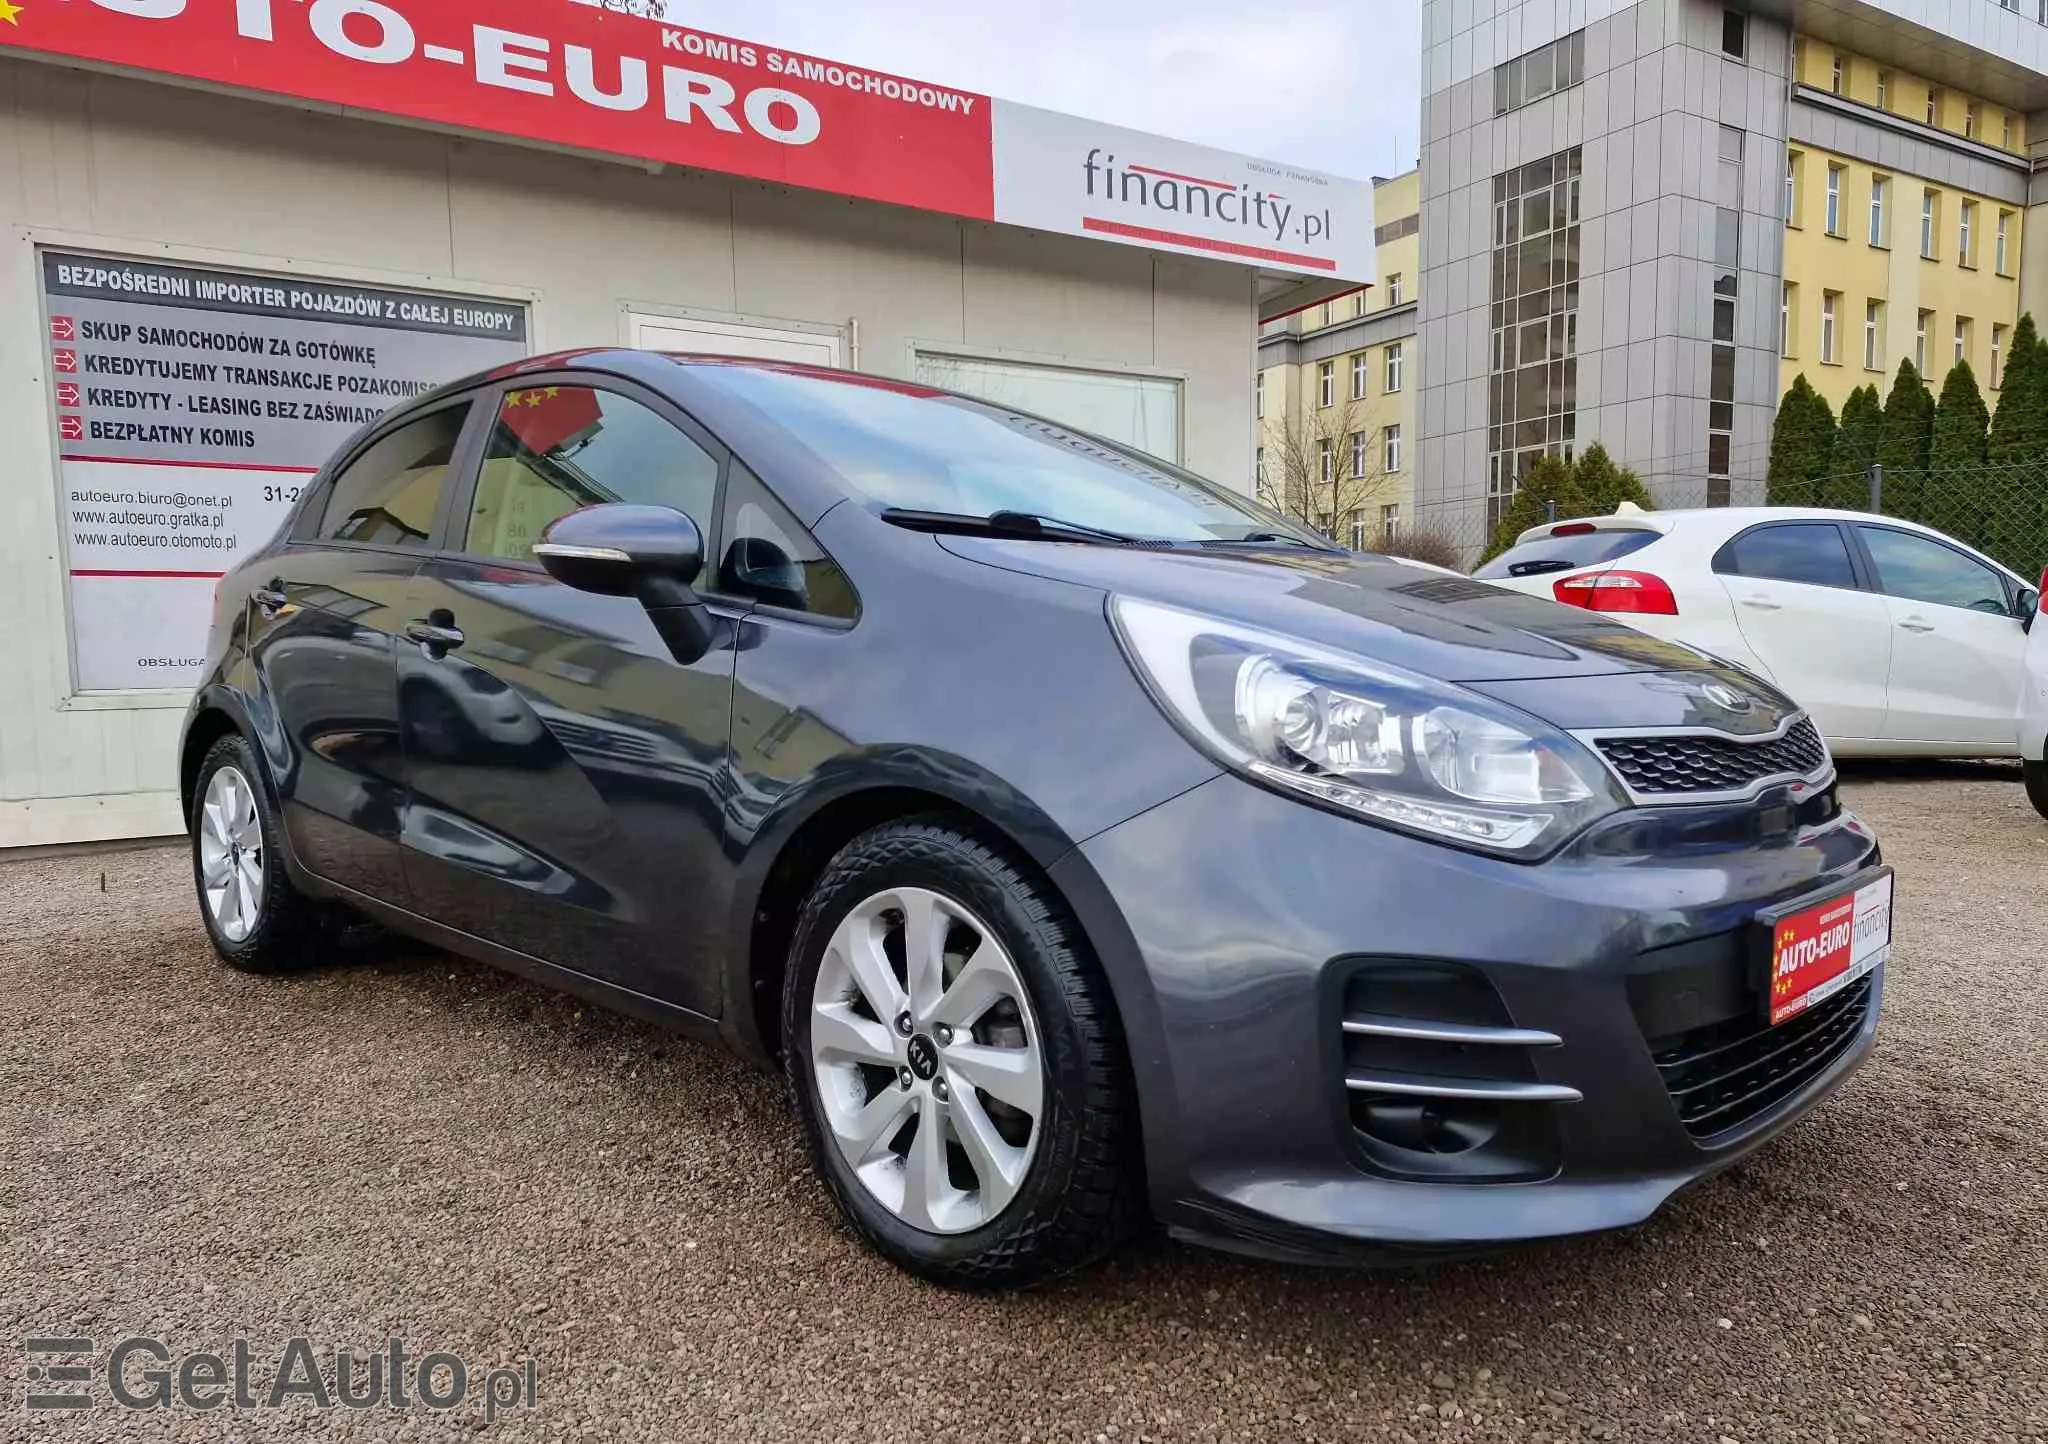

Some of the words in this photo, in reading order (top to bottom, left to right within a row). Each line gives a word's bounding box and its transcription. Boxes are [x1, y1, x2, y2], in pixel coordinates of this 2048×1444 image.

[93, 0, 822, 145] TO-EURO
[661, 28, 758, 67] KOMIS
[765, 52, 975, 117] SAMOCHODOWY
[1083, 148, 1330, 244] financity.pl
[57, 264, 190, 298] BEZPOŚREDNI
[196, 279, 286, 308] IMPORTER
[290, 290, 382, 317] POJAZDÓW
[385, 301, 397, 319] Z
[400, 303, 449, 325] CAŁEJ
[454, 309, 514, 331] EUROPY
[81, 319, 132, 343] SKUP
[138, 325, 264, 355] SAMOCHODÓW
[269, 338, 291, 357] ZA
[296, 340, 376, 368] GOTÓWKĘ
[84, 354, 218, 382] KREDYTUJEMY
[224, 367, 333, 391] TRANSAKCJE
[87, 386, 172, 411] KREDYTY
[188, 395, 262, 418] LEASING
[267, 401, 298, 421] BEZ
[90, 420, 194, 445] BEZPŁATNY
[200, 426, 255, 449] KOMIS
[71, 489, 233, 508] autoeuro.biuro@onet.pl
[264, 485, 304, 502] 31-2
[72, 511, 224, 530] www.autoeuro.gratka.pl
[74, 532, 237, 551] www.autoeuro.otomoto.pl
[137, 657, 206, 668] OBSŁUGA
[1778, 920, 1850, 977] AUTO-EURO
[910, 1039, 932, 1075] KIA
